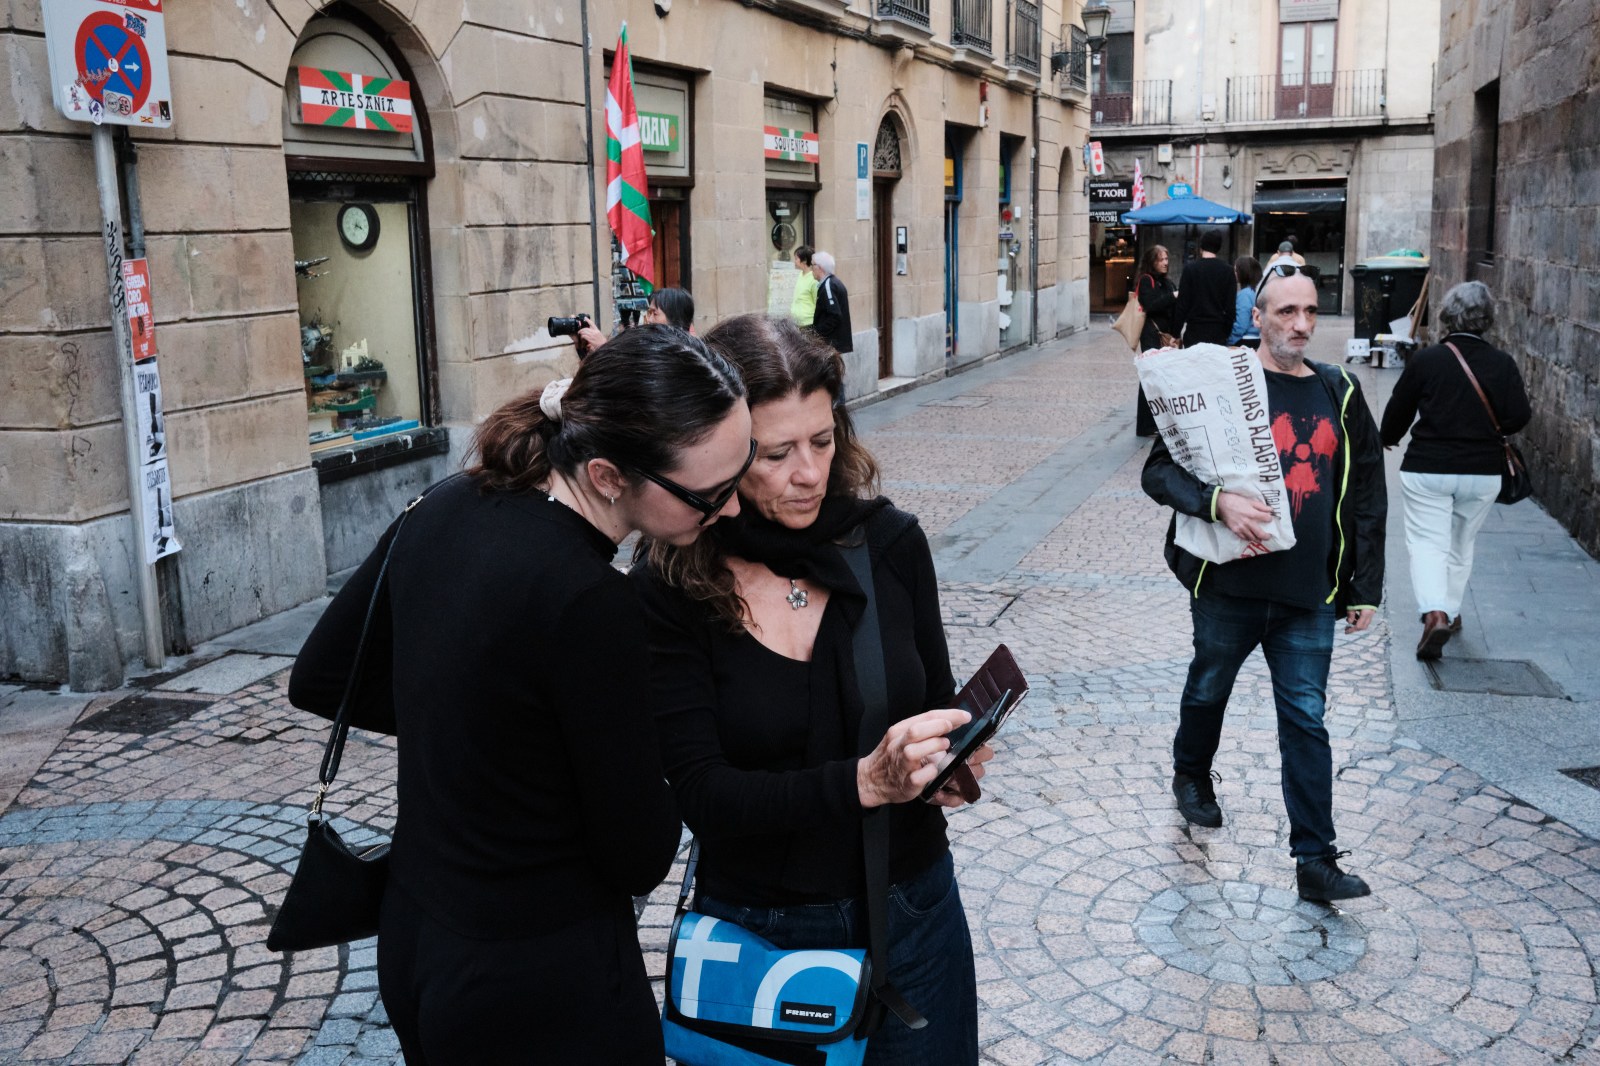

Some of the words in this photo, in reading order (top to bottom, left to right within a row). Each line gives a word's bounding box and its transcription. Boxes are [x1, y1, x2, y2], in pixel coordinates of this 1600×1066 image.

[774, 136, 809, 153] SOUVENIRS
[1097, 189, 1127, 198] TXORI
[1230, 352, 1265, 422] HARINAS
[1248, 424, 1281, 483] AZAGRA
[785, 1008, 831, 1019] FREITAG
